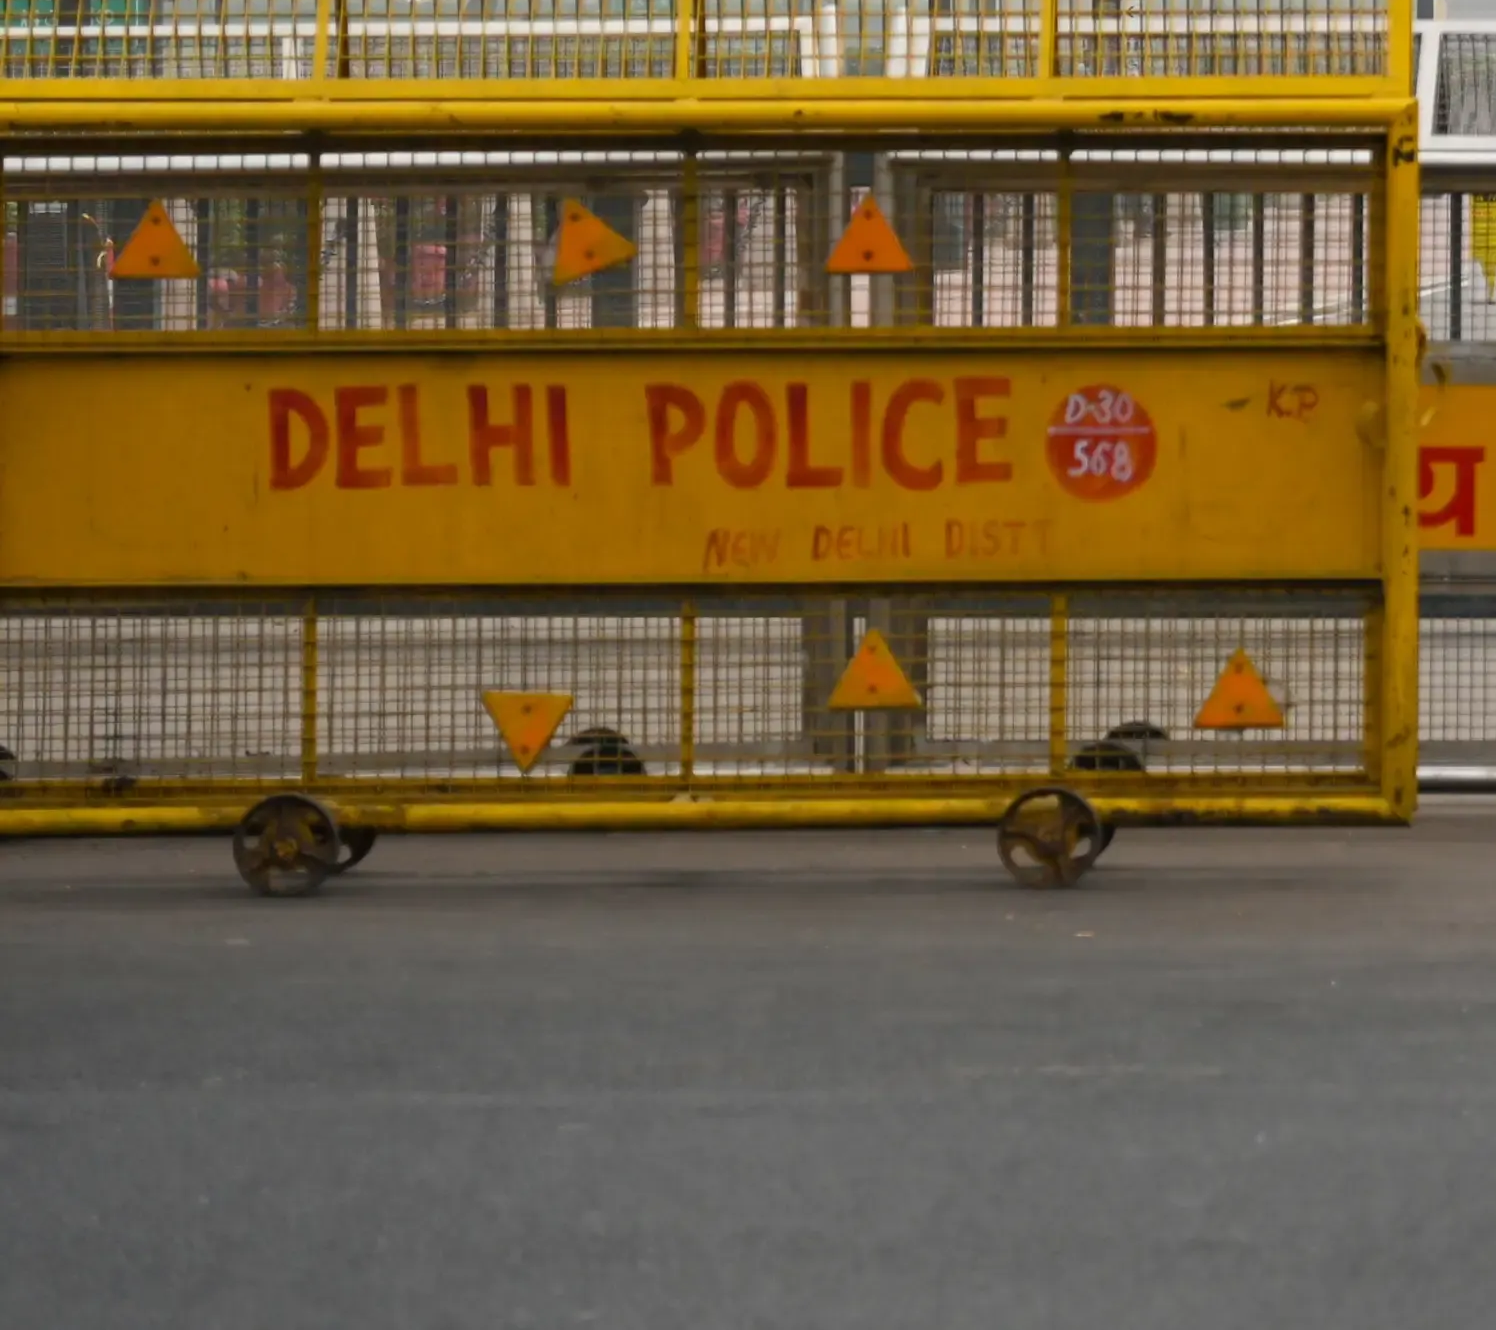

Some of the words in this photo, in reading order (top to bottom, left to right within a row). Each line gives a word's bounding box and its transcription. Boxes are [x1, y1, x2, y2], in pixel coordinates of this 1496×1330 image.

[1064, 388, 1135, 424] D-30
[268, 383, 571, 490] DELHI
[645, 377, 1011, 491] POLICE
[1067, 438, 1135, 483] 568
[702, 526, 782, 573] NEW
[811, 520, 911, 562] DELHI
